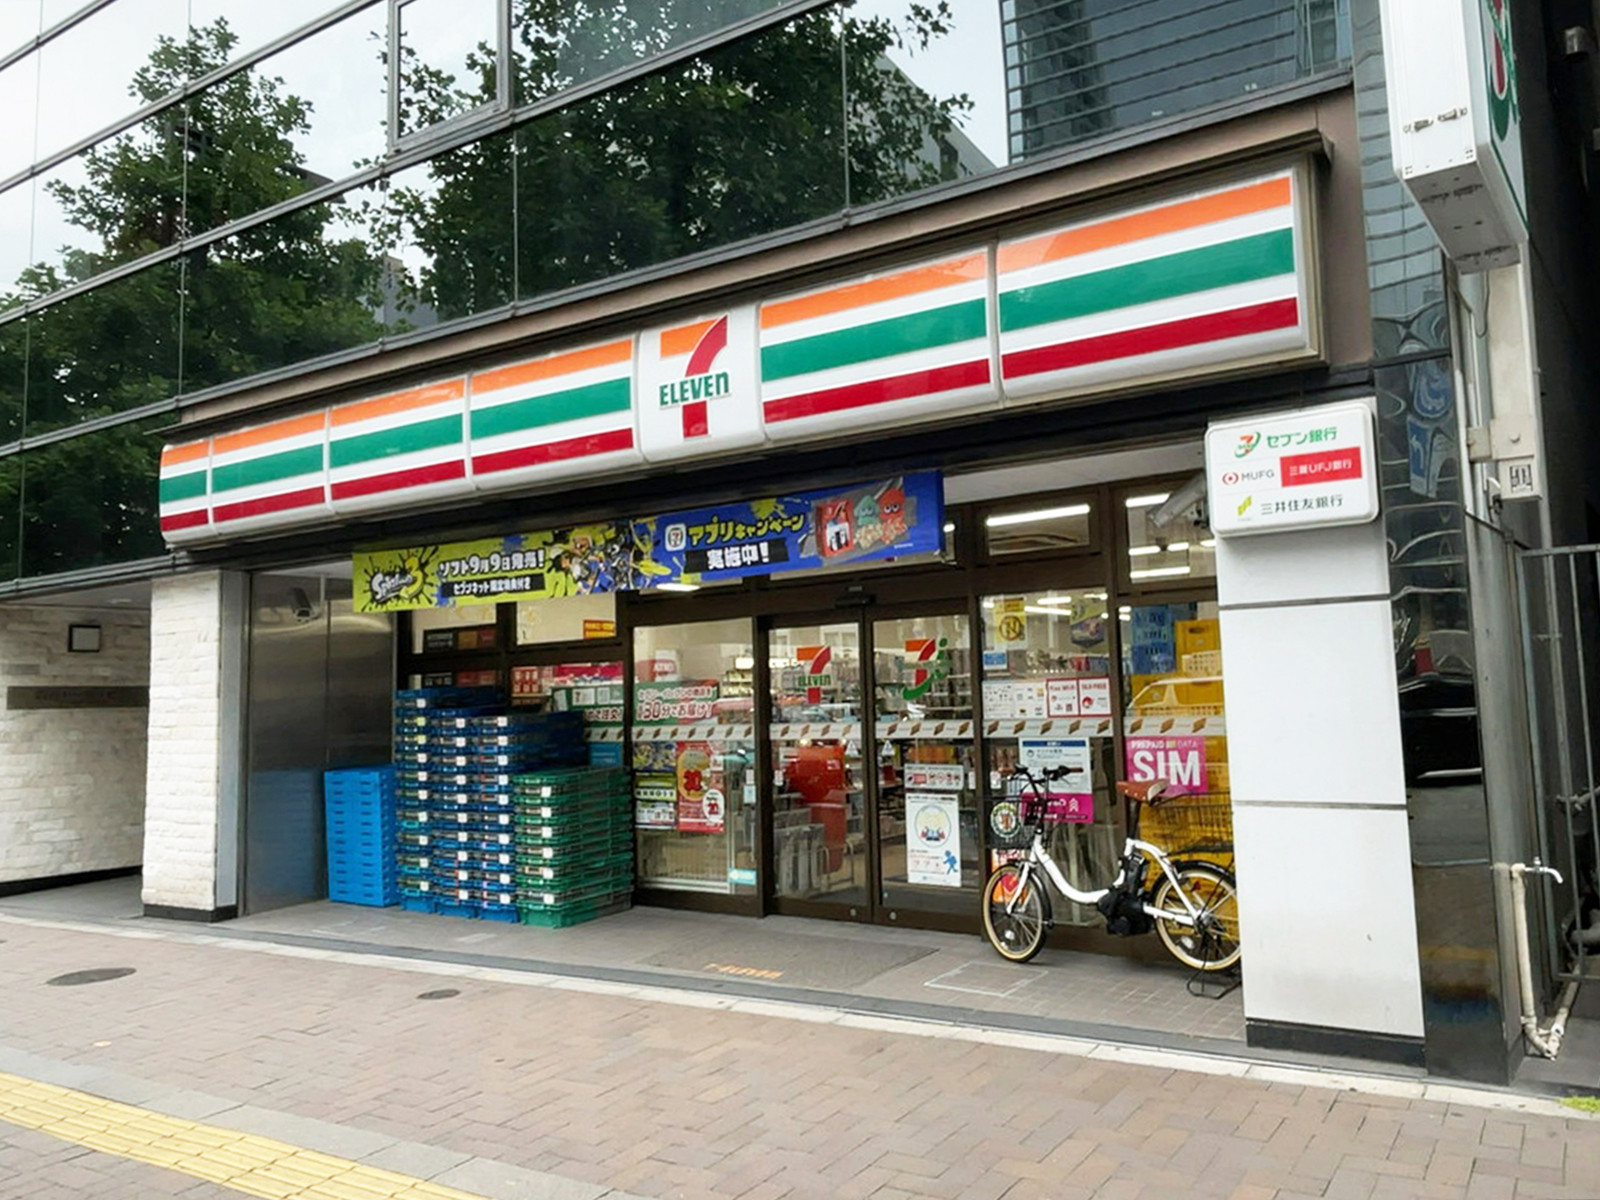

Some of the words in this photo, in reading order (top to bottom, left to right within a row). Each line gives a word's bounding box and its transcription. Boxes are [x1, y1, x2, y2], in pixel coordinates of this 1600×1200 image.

[1266, 427, 1338, 449] セブン銀行
[1241, 469, 1275, 481] MUFG
[1260, 494, 1343, 516] 三井住友銀行
[688, 514, 804, 546] アプリキャンペーン
[1133, 749, 1201, 787] SIM
